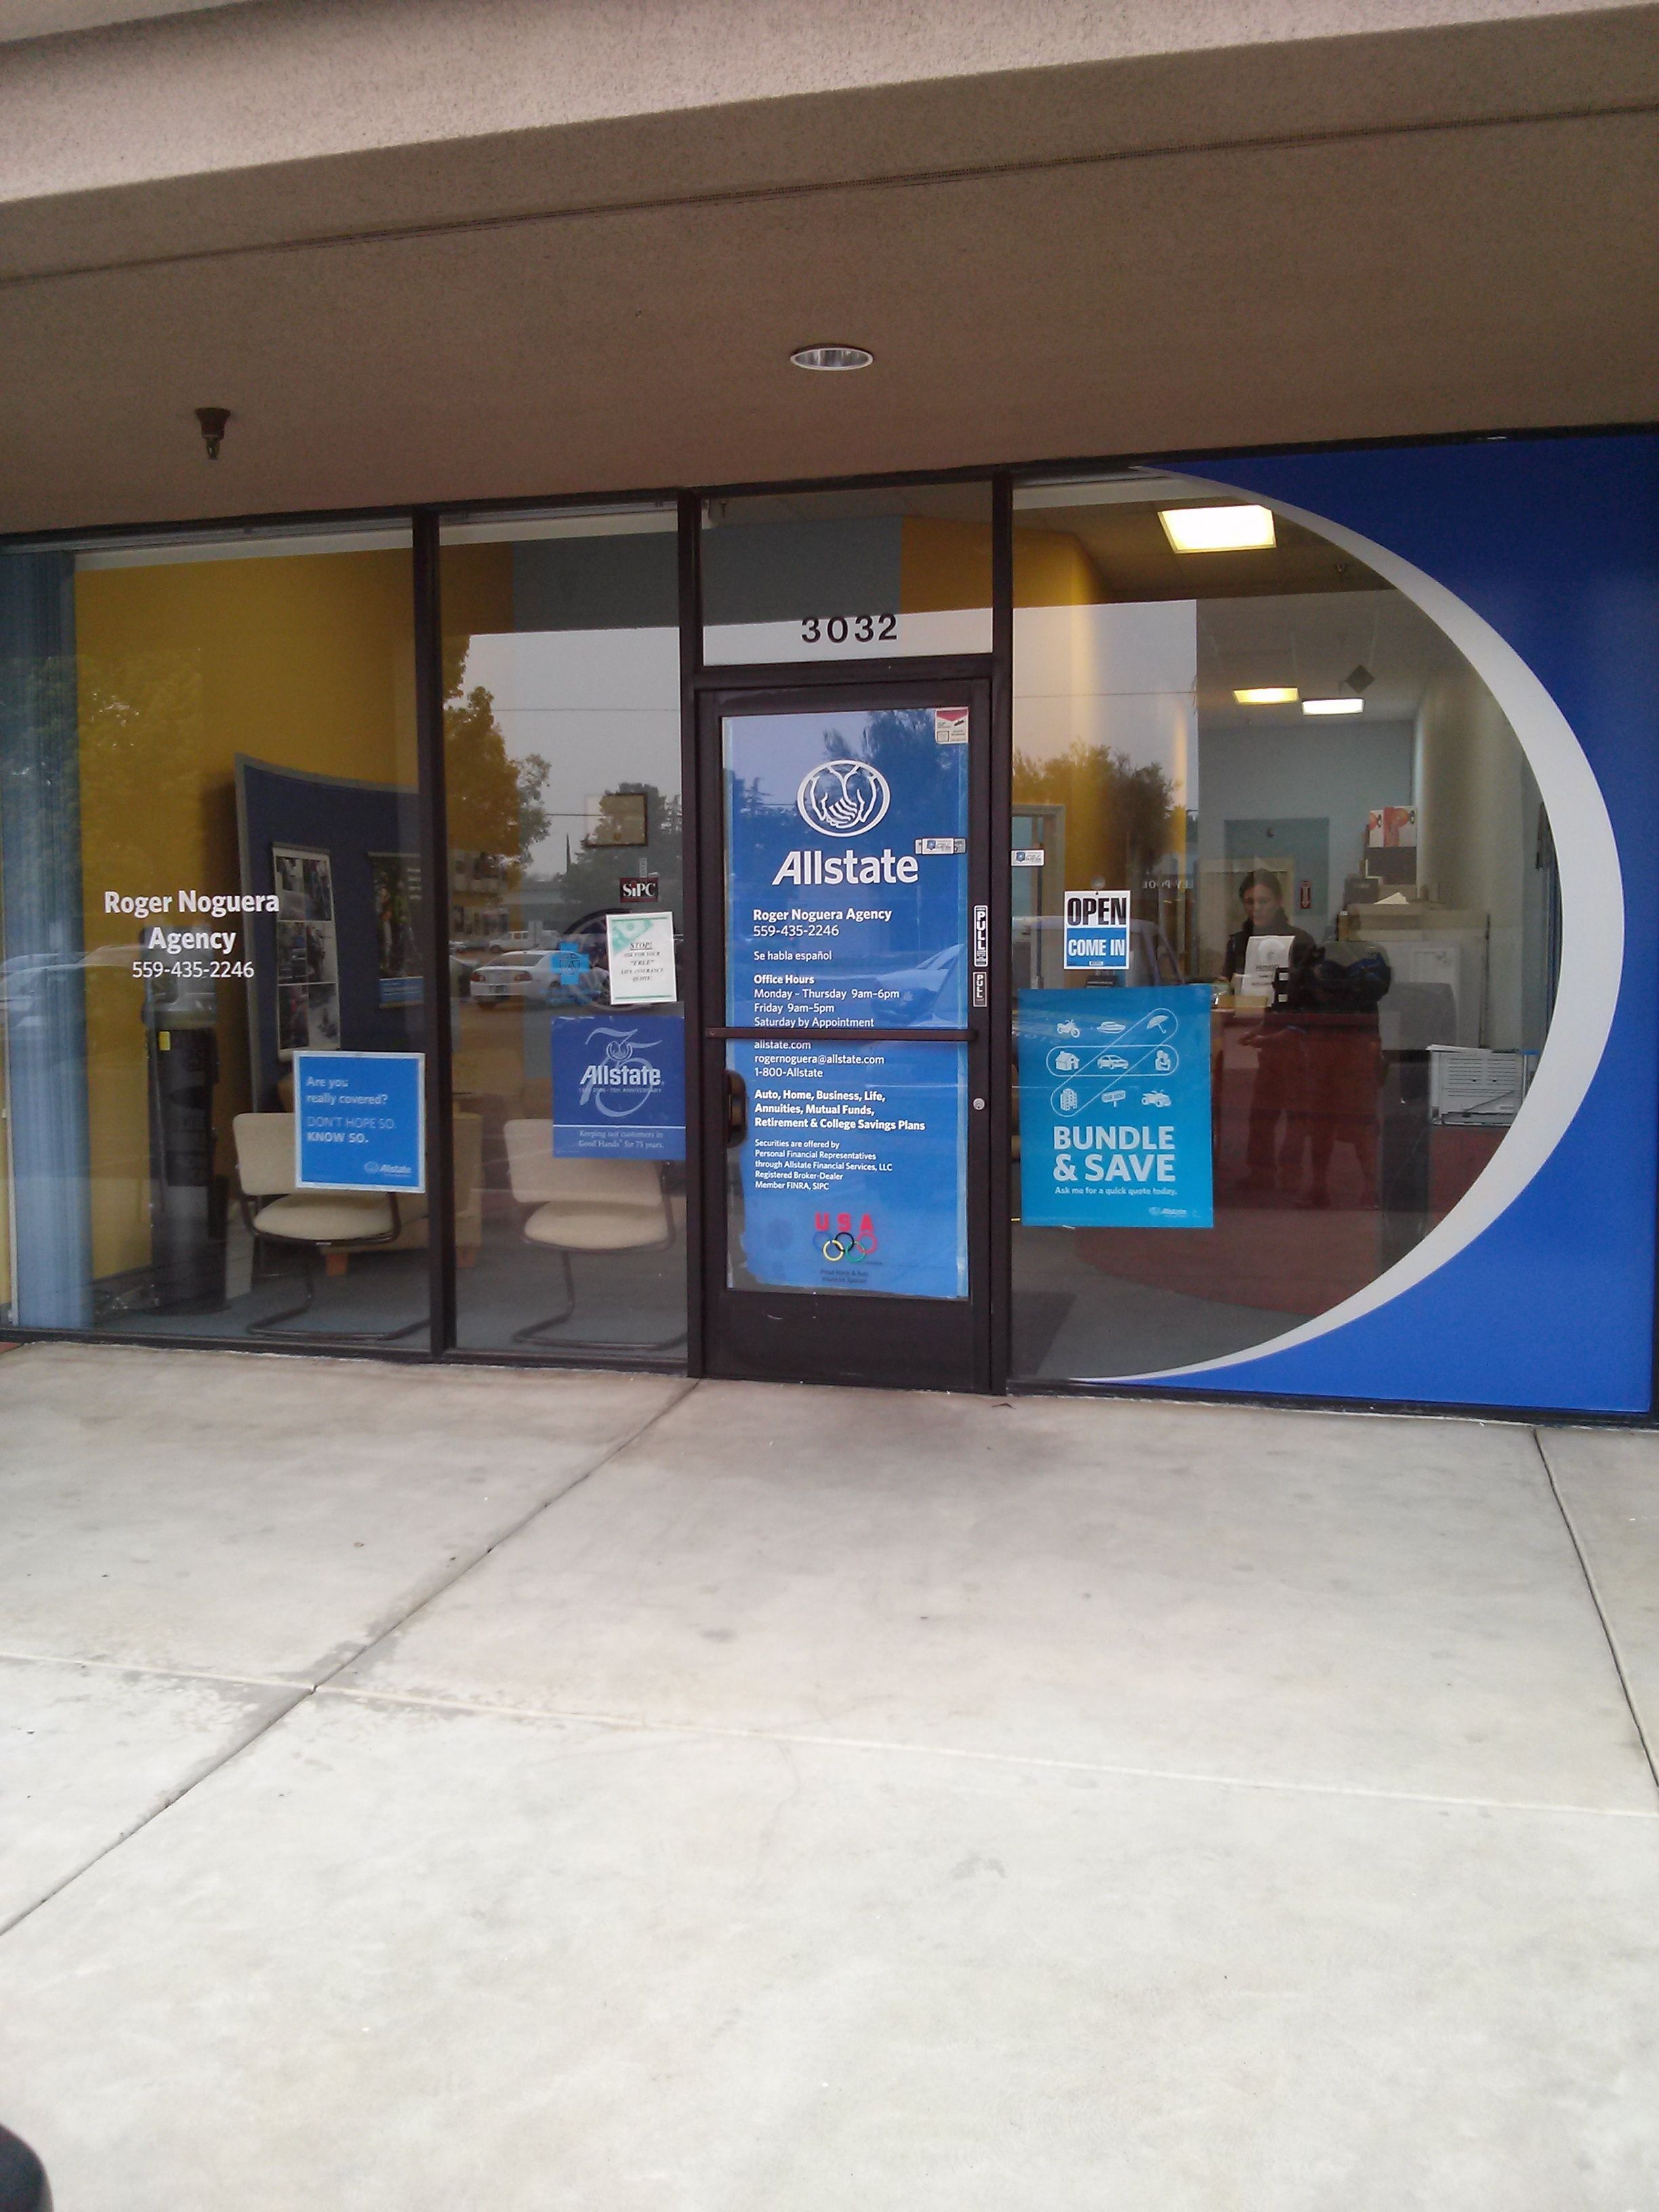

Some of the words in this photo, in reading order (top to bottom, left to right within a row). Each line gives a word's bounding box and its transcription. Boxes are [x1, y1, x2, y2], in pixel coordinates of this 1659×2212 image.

[801, 613, 898, 643] 3032
[772, 849, 918, 885] Allstate
[104, 890, 173, 918] Roger
[178, 889, 280, 917] Noguera
[754, 909, 788, 922] Roger
[792, 909, 843, 922] Noguera
[846, 907, 892, 922] Agency
[1067, 897, 1126, 926] OPEN
[754, 924, 840, 937] 559-435-2246
[977, 911, 986, 950] PULL
[148, 926, 236, 954] Agency
[1068, 939, 1107, 956] COME
[1110, 939, 1126, 956] IN
[754, 951, 764, 960] Se
[767, 951, 793, 960] habla
[796, 949, 832, 962] español
[132, 960, 255, 979] 559-435-2246
[754, 975, 783, 984] Office
[785, 975, 815, 984] Hours
[754, 989, 793, 1000] Monday
[802, 988, 847, 1000] Thursday
[754, 1003, 783, 1015] Friday
[754, 1017, 796, 1028] Saturday
[798, 1017, 809, 1028] by
[811, 1017, 874, 1029] Appointment
[754, 1040, 811, 1050] allstate.com
[754, 1054, 884, 1065] rogernoguera@allstate.com
[579, 1065, 662, 1086] Allstate
[754, 1067, 823, 1078] 1-800-Allstate
[306, 1076, 326, 1087] Are
[329, 1078, 348, 1089] you
[307, 1092, 337, 1105] really
[340, 1093, 388, 1105] covered?
[754, 1089, 781, 1101] Auto,
[783, 1090, 815, 1101] Home,
[816, 1090, 862, 1102] Business,
[864, 1090, 886, 1103] Life,
[754, 1103, 804, 1115] Annuities,
[806, 1104, 840, 1115] Mutual
[842, 1105, 875, 1116] Funds,
[308, 1116, 343, 1128] DON'T
[346, 1118, 376, 1128] HOPE
[754, 1118, 808, 1128] Retirement
[810, 1118, 819, 1128] &
[820, 1118, 857, 1130] College
[858, 1119, 897, 1132] Savings
[898, 1120, 926, 1130] Plans
[308, 1131, 346, 1143] KNOW
[348, 1132, 369, 1143] SO.
[579, 1130, 607, 1139] Keeping
[1053, 1126, 1176, 1150] BUNDLE
[579, 1139, 597, 1147] Good
[624, 1140, 634, 1148] for
[754, 1139, 790, 1147] Securities
[804, 1140, 830, 1148] offered
[830, 1141, 840, 1150] by
[755, 1149, 785, 1158] Personal
[786, 1150, 818, 1159] Financial
[819, 1151, 876, 1161] Representatives
[380, 1164, 412, 1174] Allstate
[755, 1160, 783, 1170] through
[784, 1161, 812, 1169] Allstate
[813, 1162, 844, 1170] Financial
[846, 1162, 877, 1172] Services,
[879, 1163, 893, 1171] LLC
[1052, 1153, 1078, 1181] &
[1084, 1153, 1176, 1182] SAVE
[755, 1170, 792, 1180] Registered
[794, 1171, 844, 1181] Broker-Dealer
[755, 1181, 785, 1189] Member
[786, 1181, 811, 1191] FINRA,
[813, 1182, 829, 1190] SIPC
[1105, 1187, 1126, 1196] quick
[1128, 1188, 1151, 1196] quote
[1153, 1187, 1177, 1197] today.
[815, 1210, 874, 1232] USA
